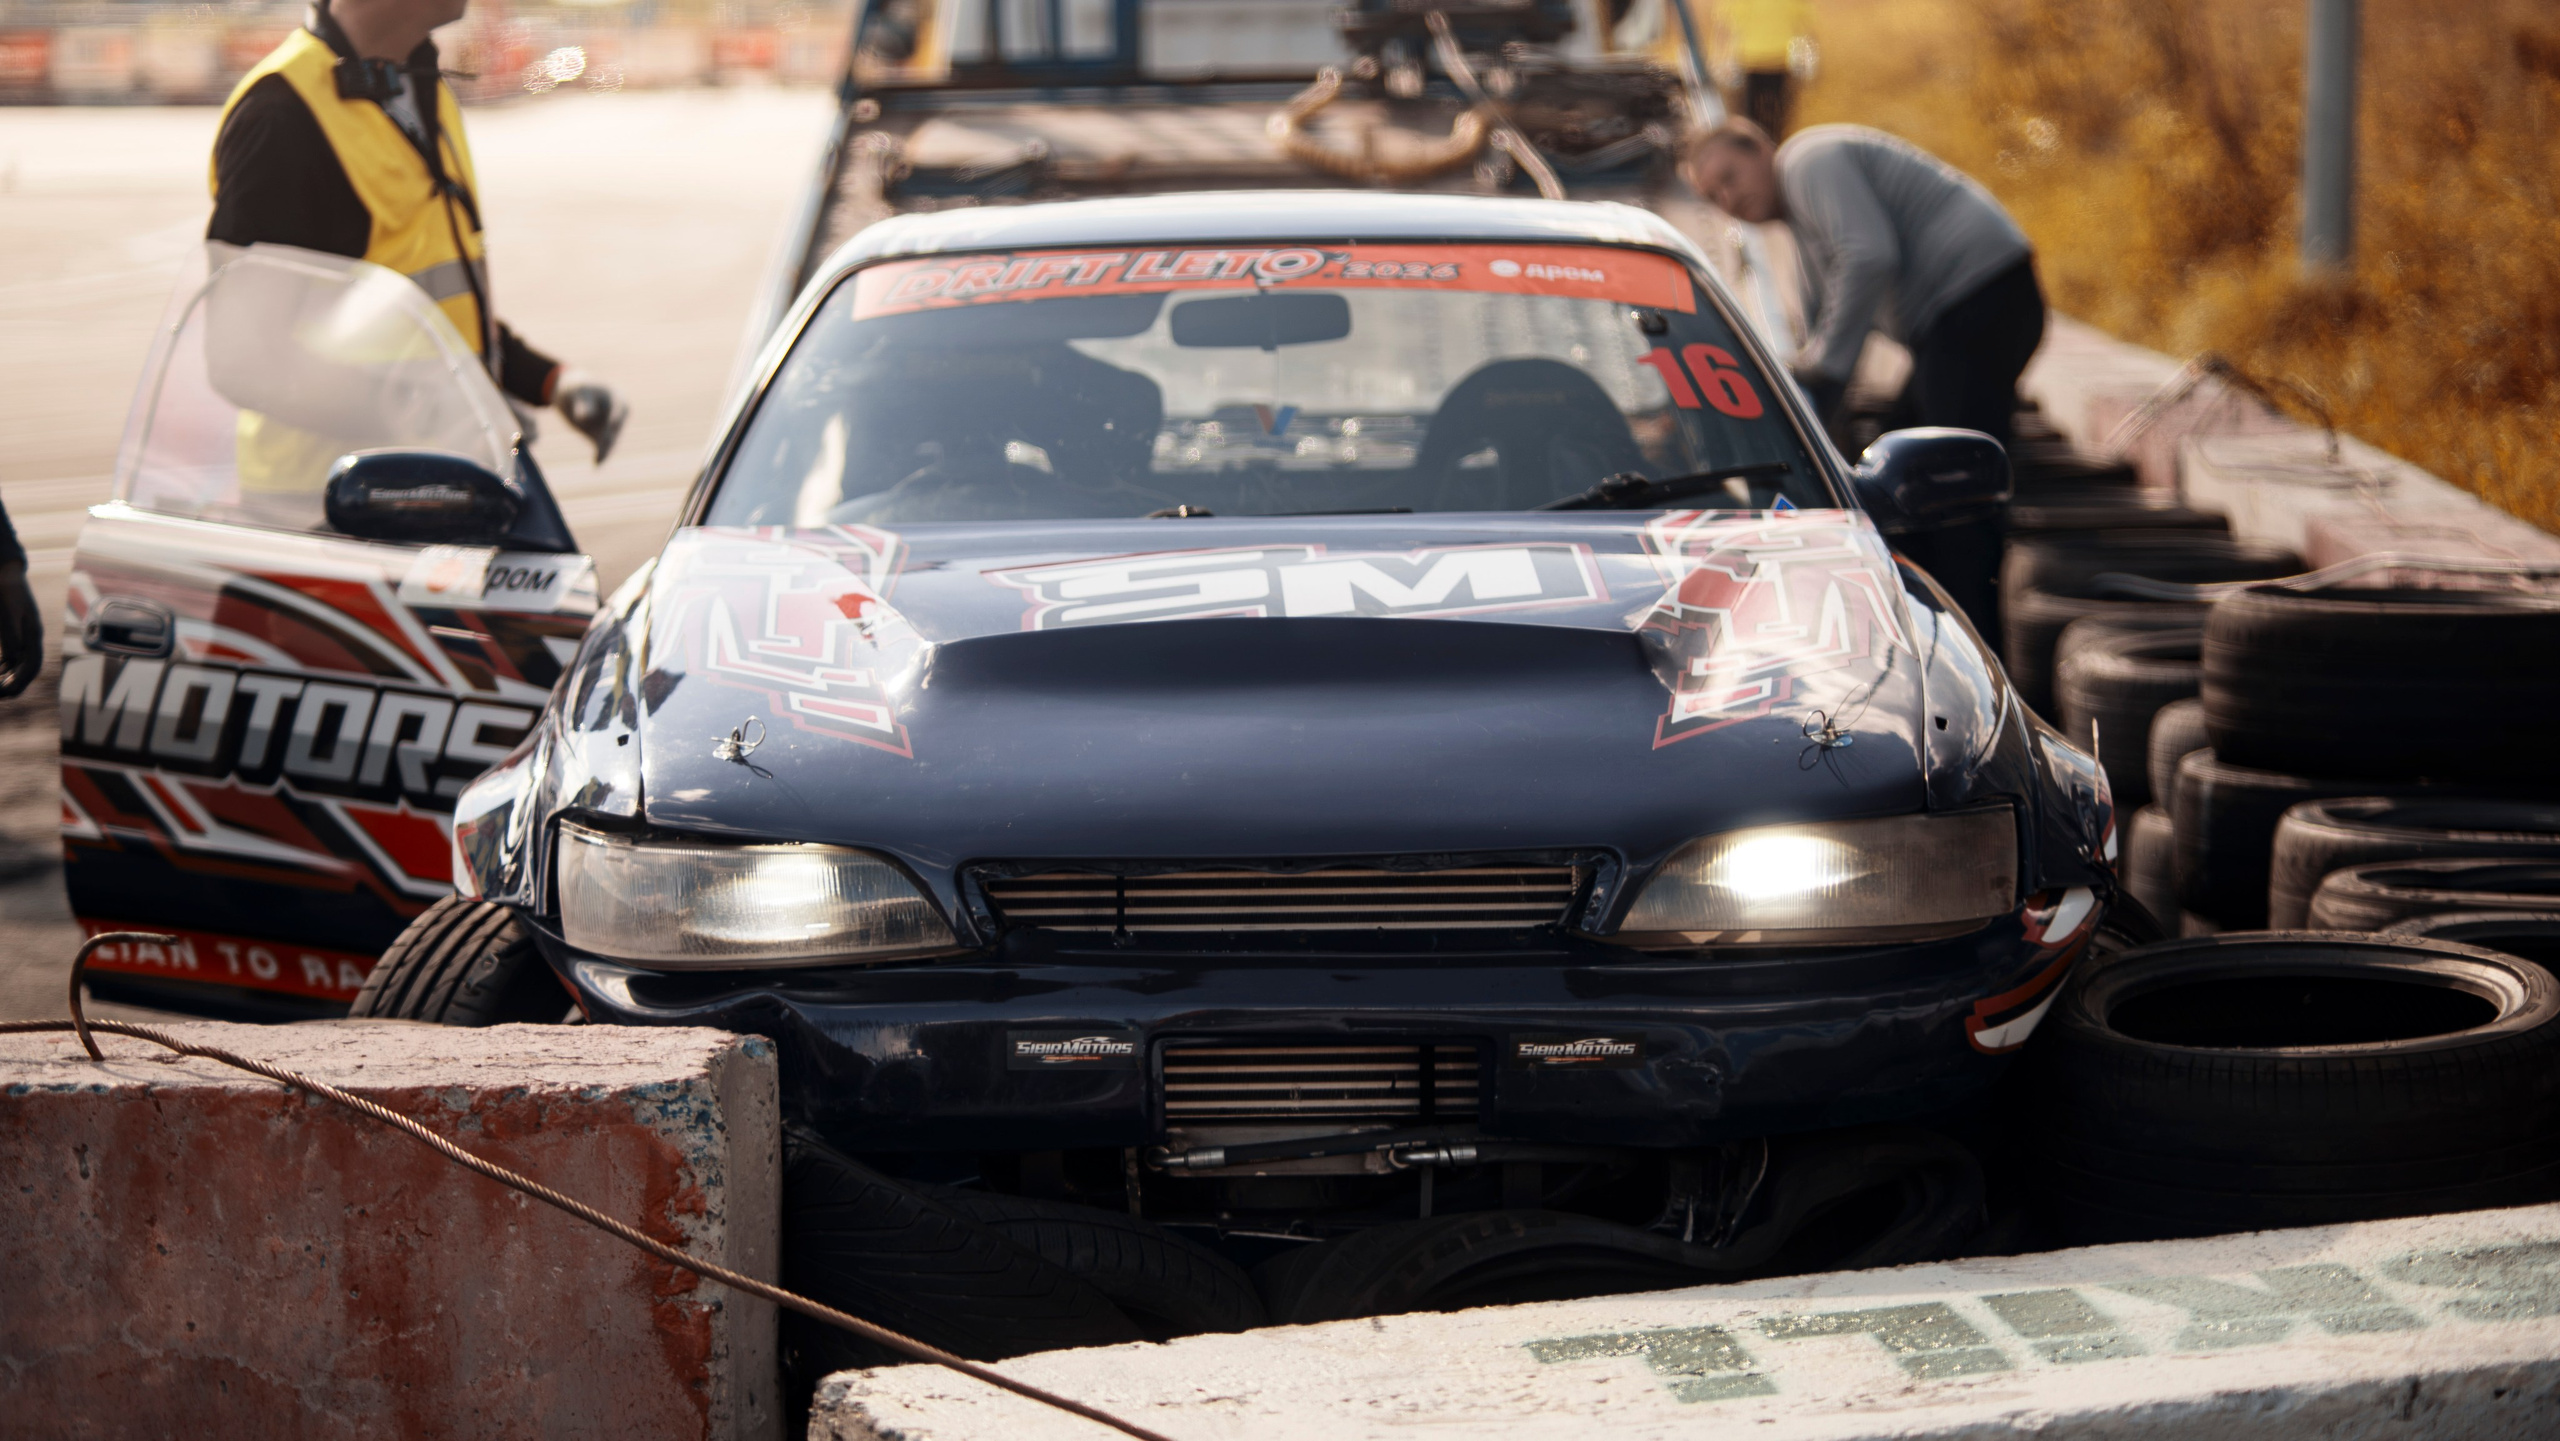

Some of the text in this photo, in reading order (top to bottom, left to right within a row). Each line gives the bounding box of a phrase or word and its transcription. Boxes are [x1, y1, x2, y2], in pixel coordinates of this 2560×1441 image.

[886, 252, 1126, 302] DRIFT
[1125, 247, 1326, 281] LETO
[1637, 342, 1765, 420] 16
[1024, 547, 1544, 618] SM
[61, 654, 538, 797] MOTORS
[216, 940, 279, 980] TO
[298, 953, 366, 991] RA
